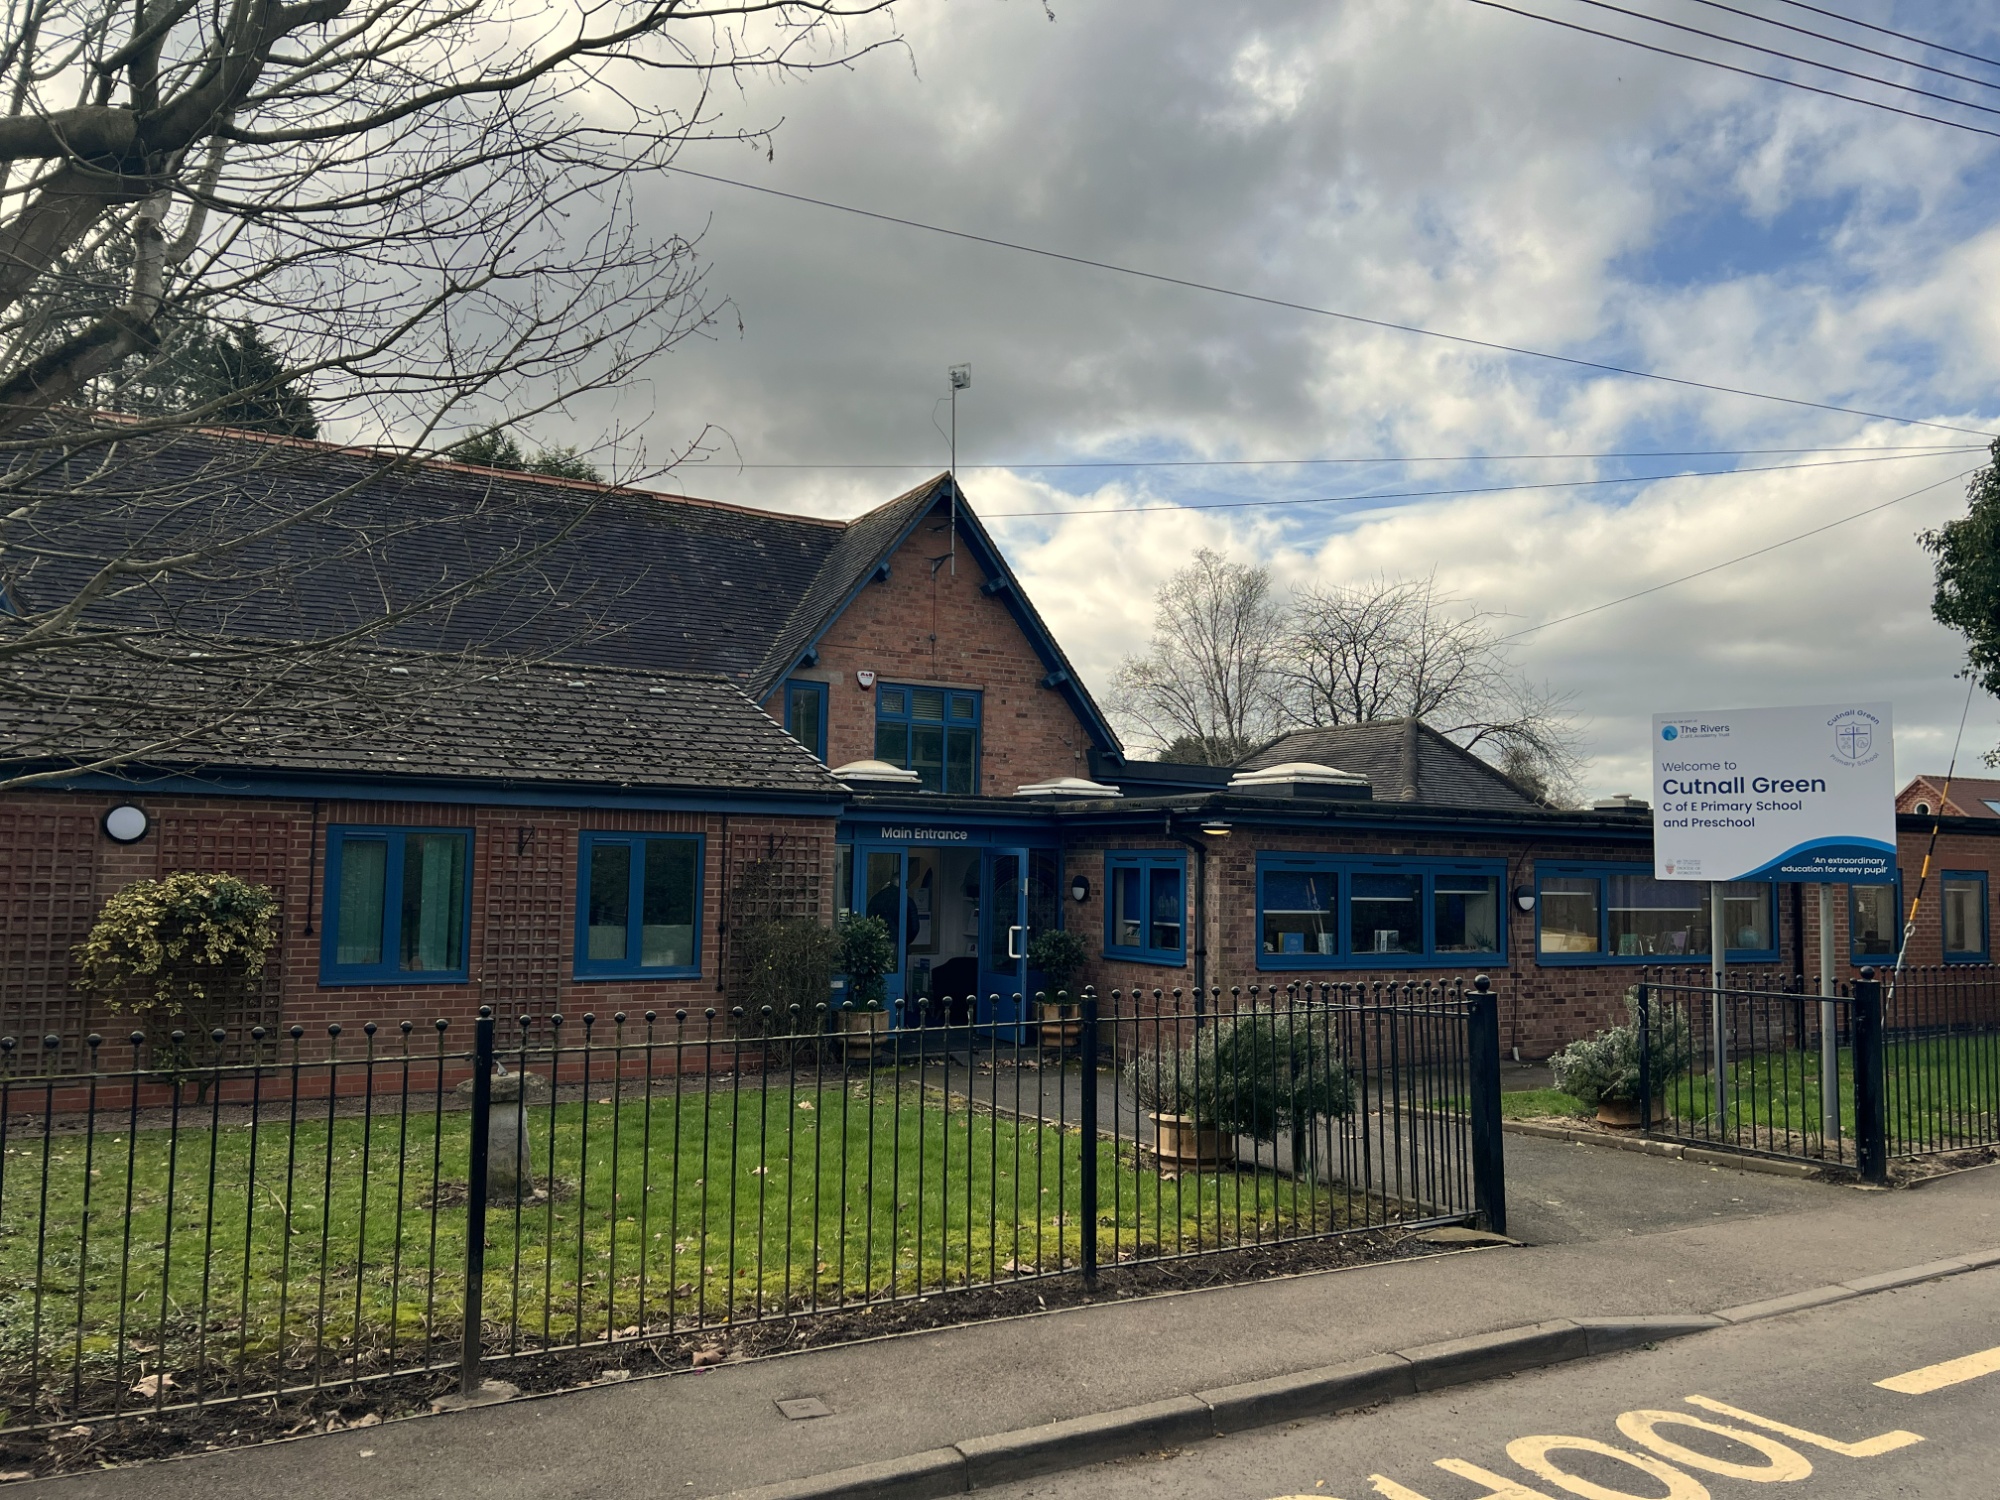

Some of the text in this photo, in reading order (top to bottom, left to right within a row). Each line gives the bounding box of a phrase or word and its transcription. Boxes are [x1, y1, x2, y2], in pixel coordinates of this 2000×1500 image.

[1826, 709, 1880, 726] Cutnall Green
[1680, 724, 1730, 734] The Rivers
[1830, 752, 1880, 768] Primary School
[1662, 761, 1737, 772] Welcome to
[1662, 777, 1826, 795] Cutnall Green
[1662, 800, 1802, 814] C of E Primary School
[1663, 817, 1755, 828] and Preschool
[881, 826, 968, 840] Main Entrance
[1827, 857, 1886, 866] extraordinary
[1781, 865, 1824, 873] education
[1825, 865, 1837, 873] for
[1838, 866, 1861, 875] every
